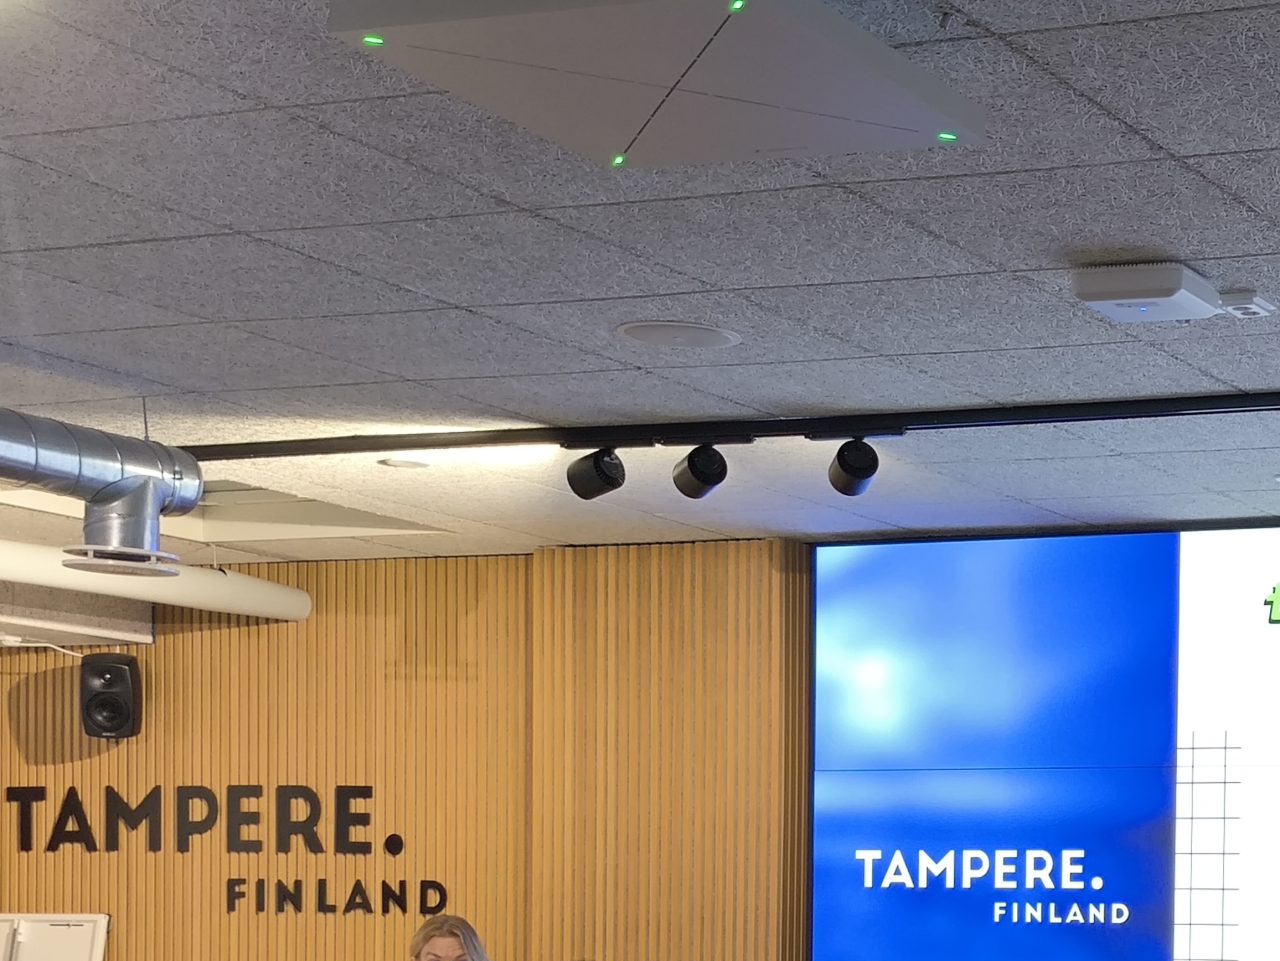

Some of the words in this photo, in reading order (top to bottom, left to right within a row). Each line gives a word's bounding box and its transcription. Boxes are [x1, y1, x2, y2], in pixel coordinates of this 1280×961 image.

[7, 785, 404, 855] TAMPERE.
[855, 850, 1103, 890] TAMPERE.
[227, 878, 448, 915] FINLAND
[993, 902, 1130, 924] FINLAND
